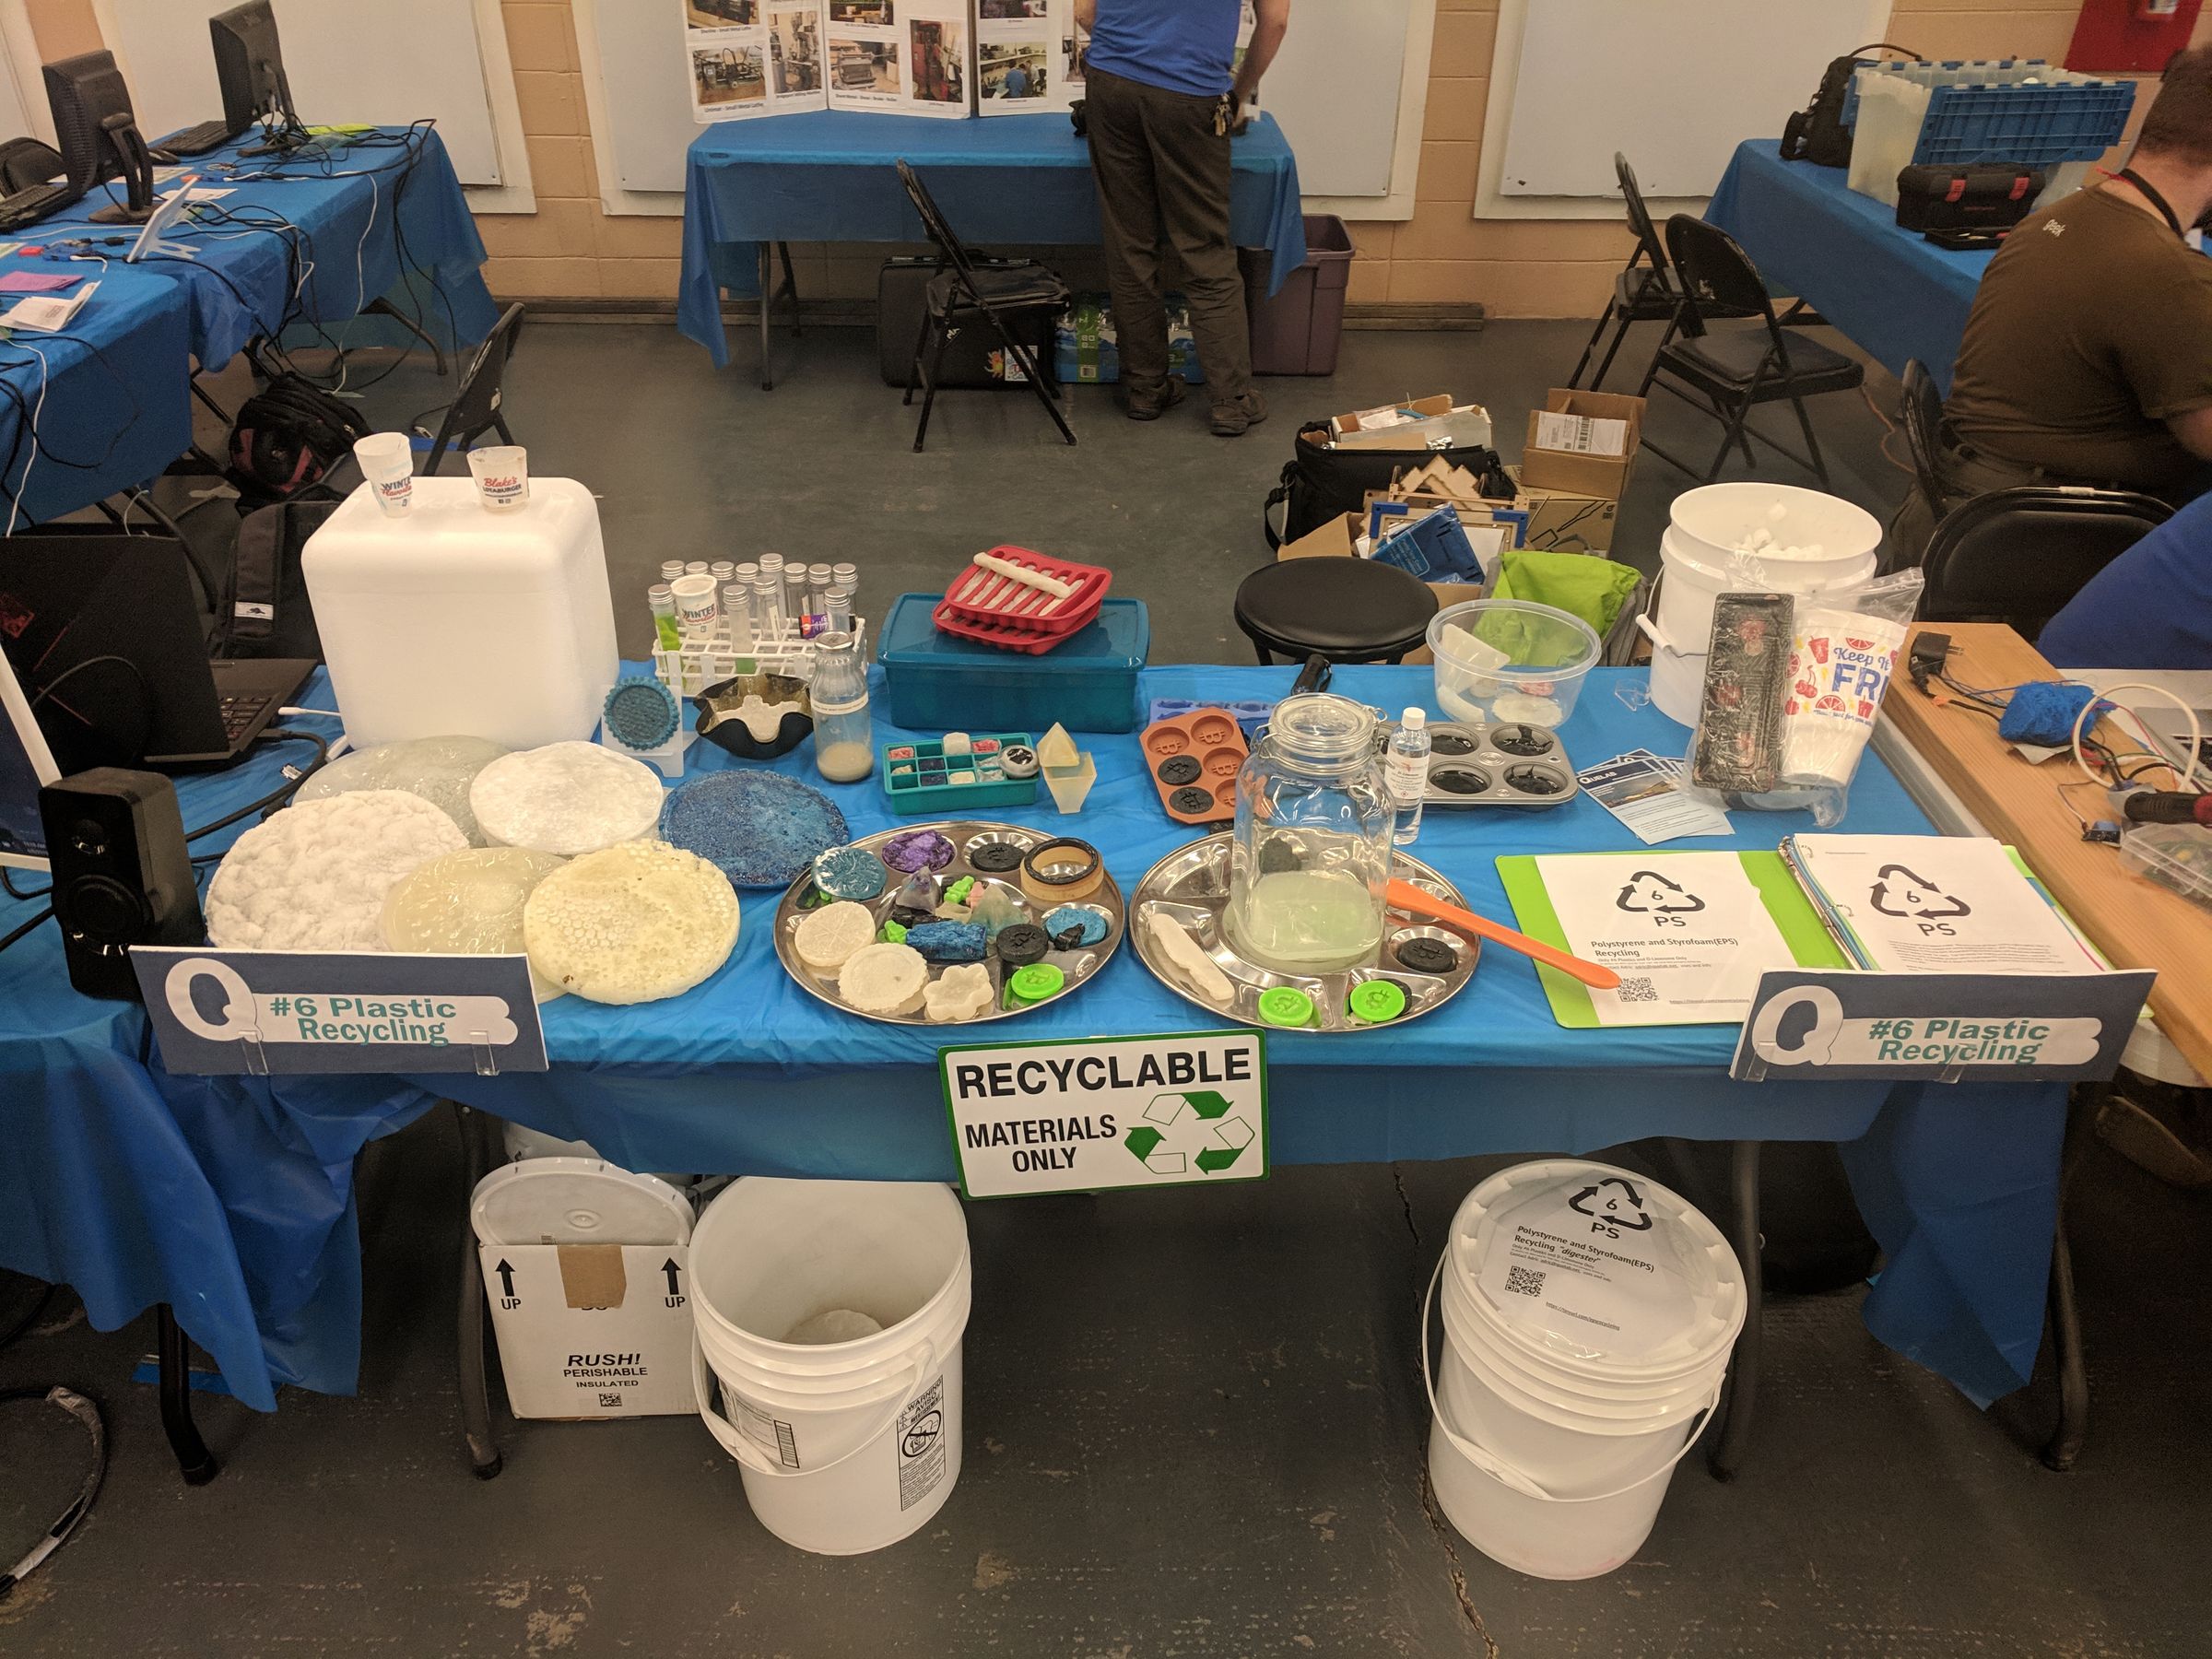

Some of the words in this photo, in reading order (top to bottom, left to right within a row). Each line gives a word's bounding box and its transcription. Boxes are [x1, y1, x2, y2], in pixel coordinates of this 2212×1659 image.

[484, 477, 518, 488] Blake's
[1833, 647, 1874, 666] Keep
[1877, 656, 1890, 671] It
[1651, 889, 1665, 900] 6
[1906, 890, 1922, 903] 6
[1653, 915, 1687, 927] PS
[1916, 923, 1957, 936] PS
[1591, 939, 1646, 948] Polystyrene
[1666, 937, 1739, 947] Styrofoam(EPS)
[1594, 949, 1641, 958] Recycling
[270, 996, 318, 1018] #6
[329, 997, 457, 1018] Plastic
[298, 1018, 449, 1047] Recycling
[1868, 1019, 1914, 1040] #6
[1924, 1019, 2050, 1041] Plastic
[1877, 1039, 2043, 1065] Recycling
[956, 1047, 1252, 1100] RECYCLABLE
[965, 1113, 1118, 1149] MATERIALS
[1012, 1147, 1077, 1173] ONLY
[1606, 1198, 1618, 1210] 6
[1591, 1221, 1620, 1240] PS
[1514, 1235, 1555, 1253] Recycling
[1517, 1225, 1568, 1244] Polystyrene
[1570, 1240, 1586, 1251] and
[1588, 1245, 1654, 1274] Styrofoam(EPS)
[500, 1298, 522, 1310] UP
[665, 1296, 686, 1309] UP
[568, 1353, 641, 1367] RUSH!
[563, 1367, 648, 1378] PERISHABLE
[576, 1380, 639, 1388] INSULATED
[907, 1378, 942, 1411] WARNING
[915, 1392, 937, 1415] AVISO
